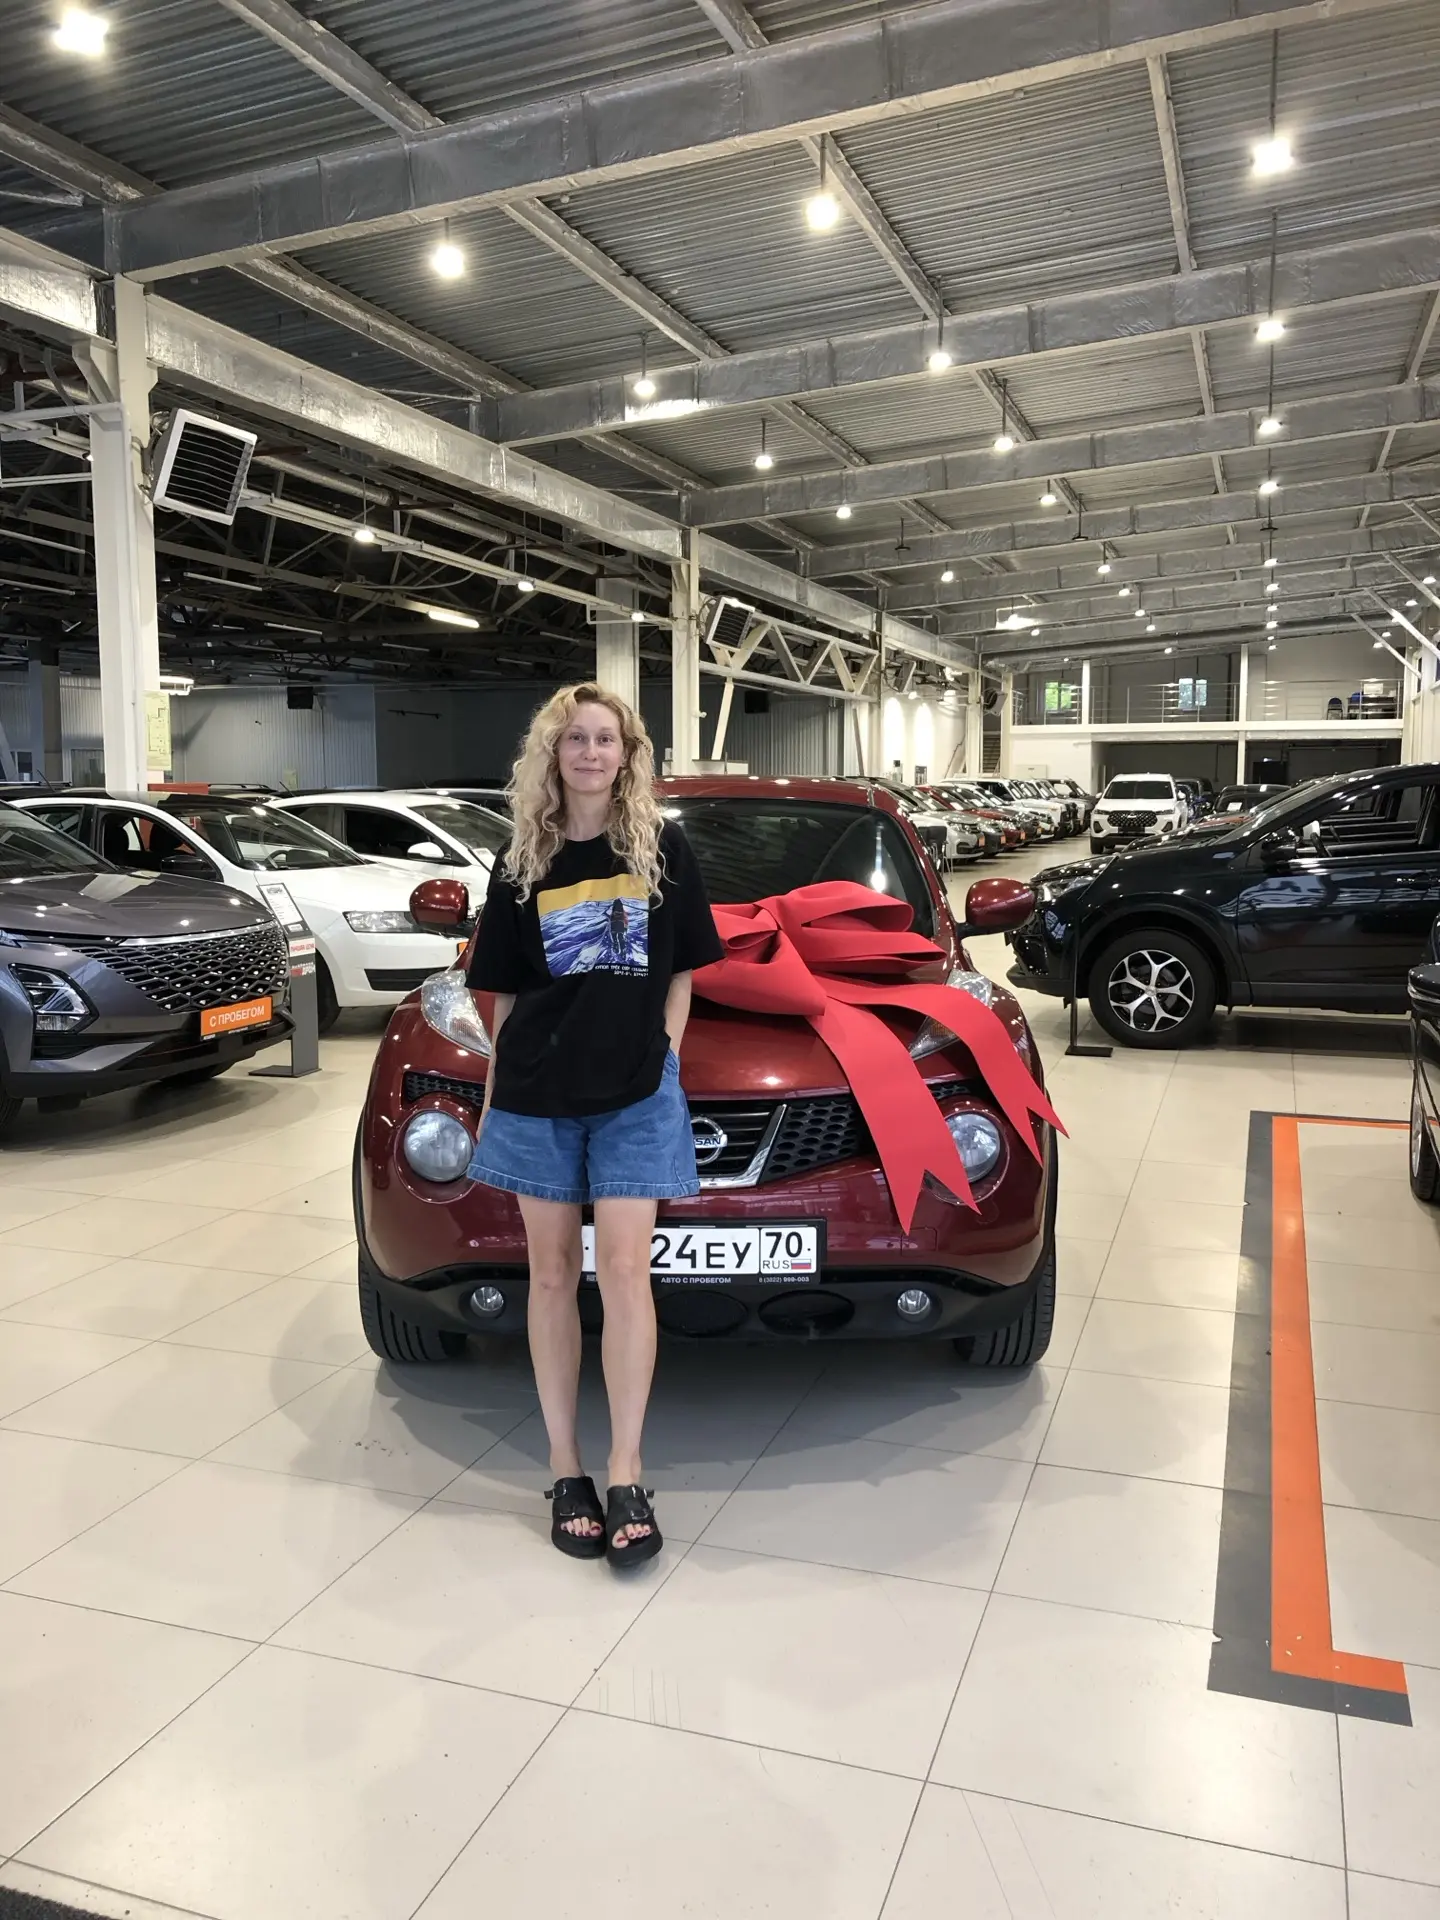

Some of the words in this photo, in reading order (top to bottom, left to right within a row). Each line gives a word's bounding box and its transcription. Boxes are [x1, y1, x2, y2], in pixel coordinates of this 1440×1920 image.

[209, 1015, 217, 1027] С
[218, 1005, 265, 1025] ПРОБЕГОМ
[765, 1231, 803, 1259] 70
[762, 1260, 790, 1269] RUS
[661, 1276, 682, 1284] АВТО
[683, 1276, 689, 1284] С
[690, 1276, 731, 1284] ПРОБЕГОМ
